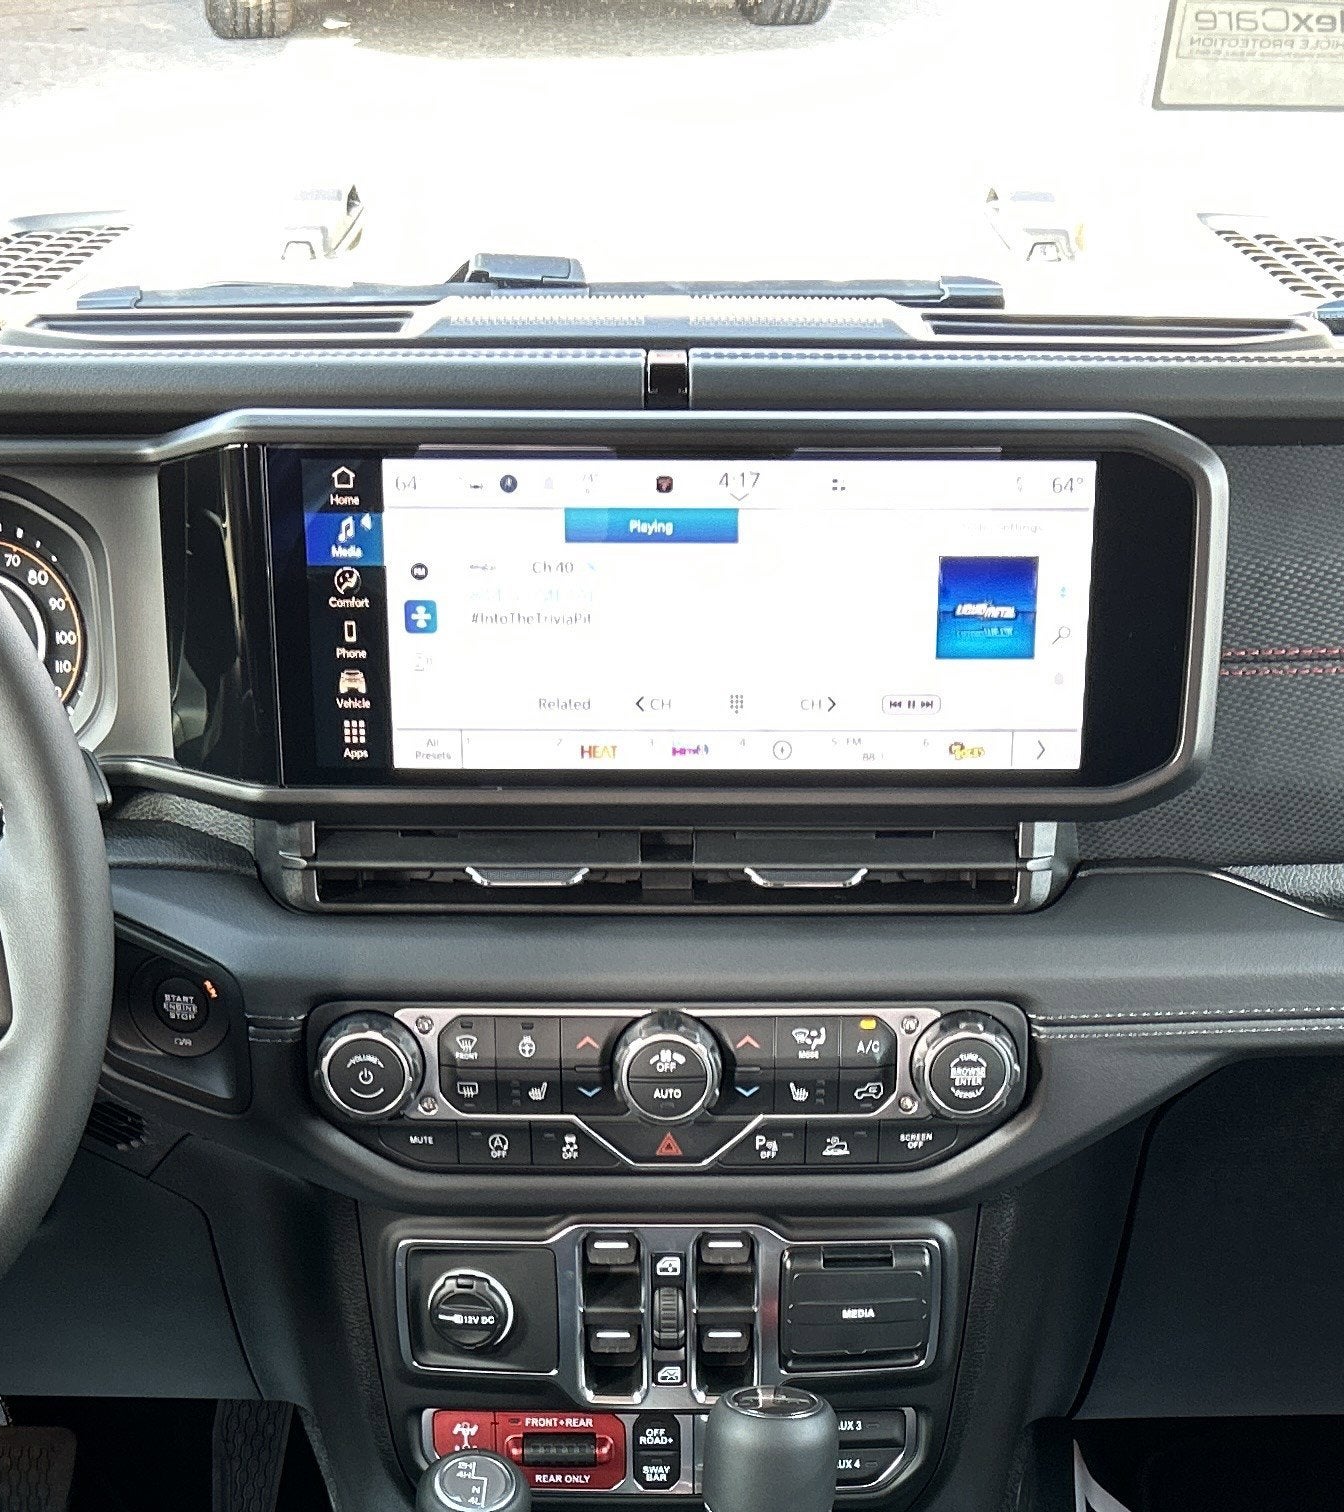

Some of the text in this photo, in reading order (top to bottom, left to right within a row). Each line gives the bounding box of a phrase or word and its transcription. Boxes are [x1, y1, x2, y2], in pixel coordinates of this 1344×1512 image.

[1052, 476, 1084, 494] 64°
[329, 493, 360, 507] Home
[629, 519, 674, 536] Playing
[5, 552, 22, 568] 70
[27, 568, 49, 586] 80
[49, 597, 66, 611] 90
[328, 596, 370, 609] Comfort
[55, 630, 77, 646] 100
[335, 647, 367, 660] Phone
[55, 658, 73, 674] 110
[335, 697, 371, 710] Vehicle
[537, 697, 591, 711] Related
[649, 698, 672, 711] CH
[799, 698, 823, 711] CH
[342, 747, 369, 761] Apps
[415, 749, 452, 761] Presets
[580, 745, 618, 760] HEAT
[164, 993, 195, 1004] START
[855, 1040, 881, 1054] A/C
[655, 1061, 678, 1073] OFF
[653, 1087, 683, 1100] AUTO
[409, 1135, 434, 1146] MUTE
[899, 1131, 934, 1142] SCREEN
[907, 1140, 924, 1149] OFF
[490, 1150, 508, 1160] OFF
[561, 1151, 579, 1160] OFF
[841, 1307, 877, 1319] MEDIA
[464, 1315, 495, 1325] 12V DC
[838, 1420, 863, 1431] UX 3
[645, 1428, 665, 1438] OFF
[639, 1436, 674, 1446] ROAD+
[642, 1465, 671, 1475] SWAY
[837, 1458, 861, 1469] UX 4
[535, 1474, 591, 1485] REAR ONLY
[471, 1485, 481, 1495] N
